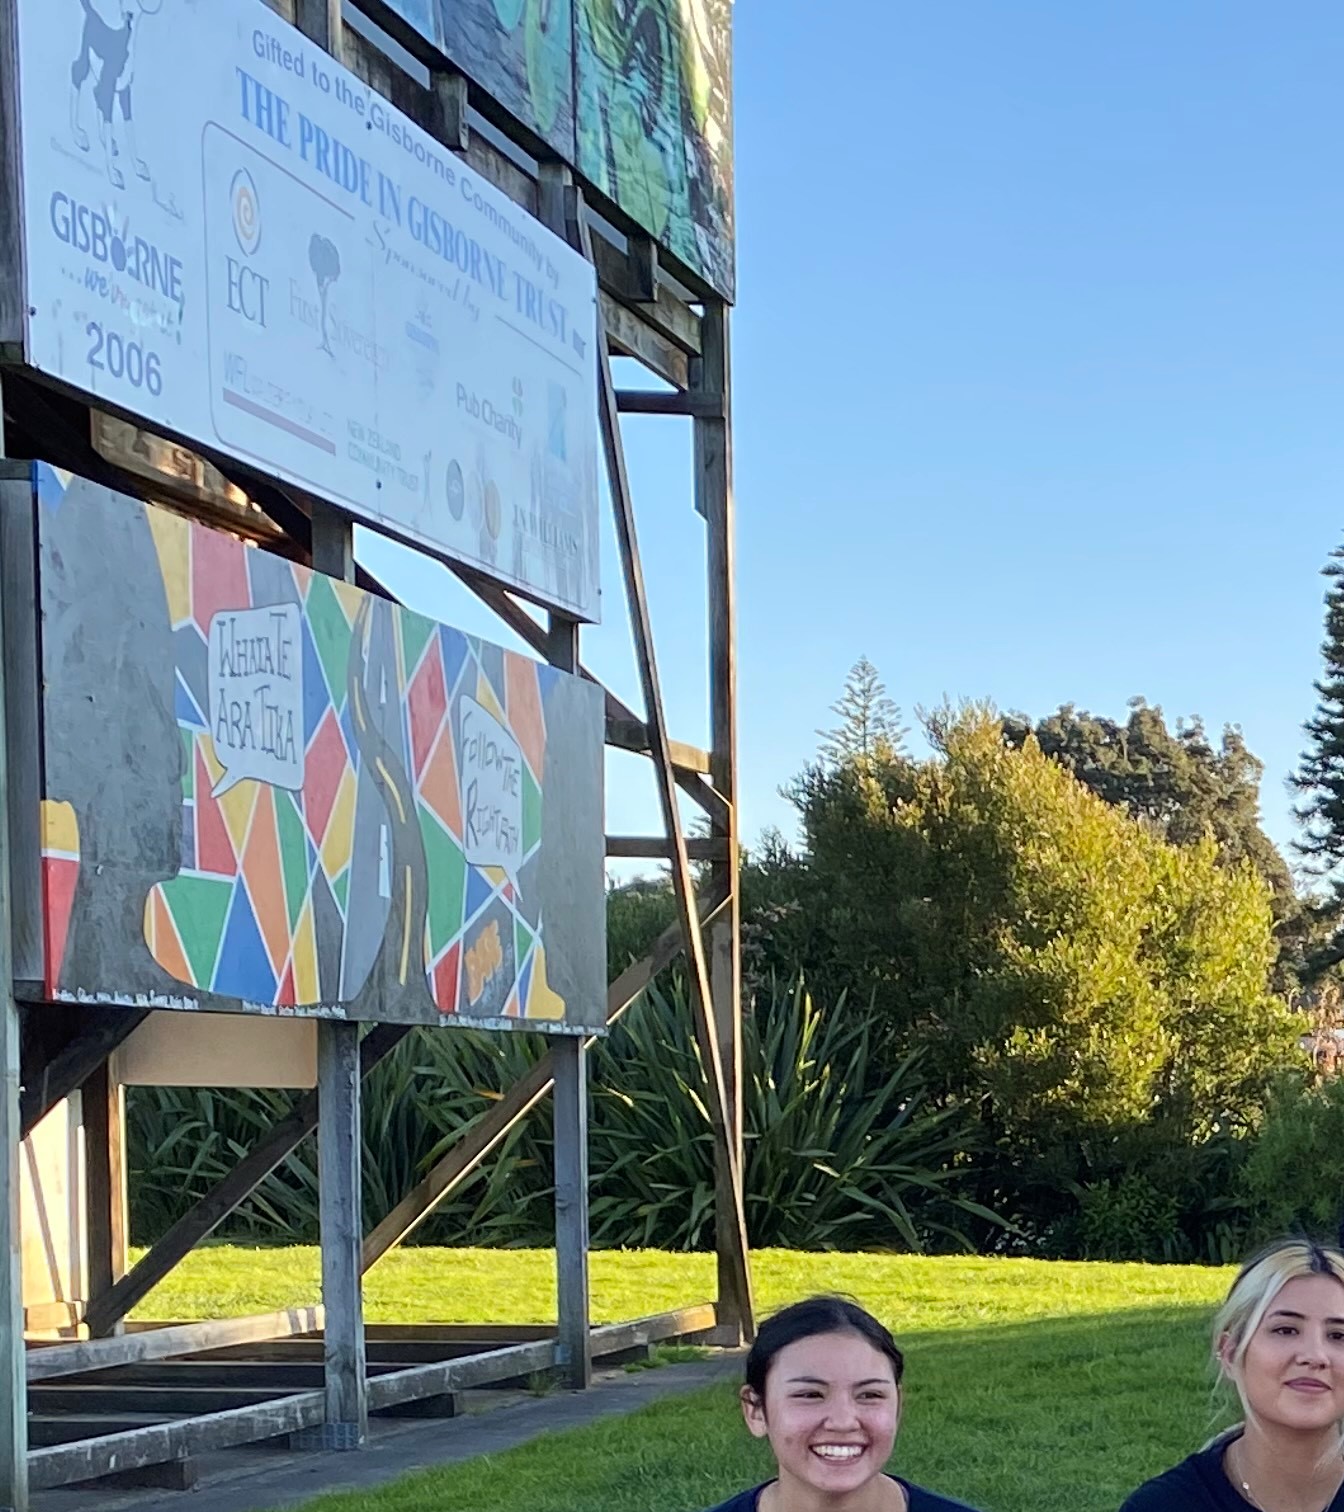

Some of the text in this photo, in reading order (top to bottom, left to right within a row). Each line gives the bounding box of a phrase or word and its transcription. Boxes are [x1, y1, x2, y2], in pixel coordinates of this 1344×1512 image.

[253, 29, 560, 290] Gifted to the Gisborne Community by
[236, 66, 569, 344] THE PRIDE IN GISBORNE TRUST
[225, 255, 269, 328] ECT
[86, 321, 163, 396] 2006
[456, 382, 522, 450] Pub Charity
[269, 611, 292, 680] TE
[216, 684, 297, 765] ARA TIKA
